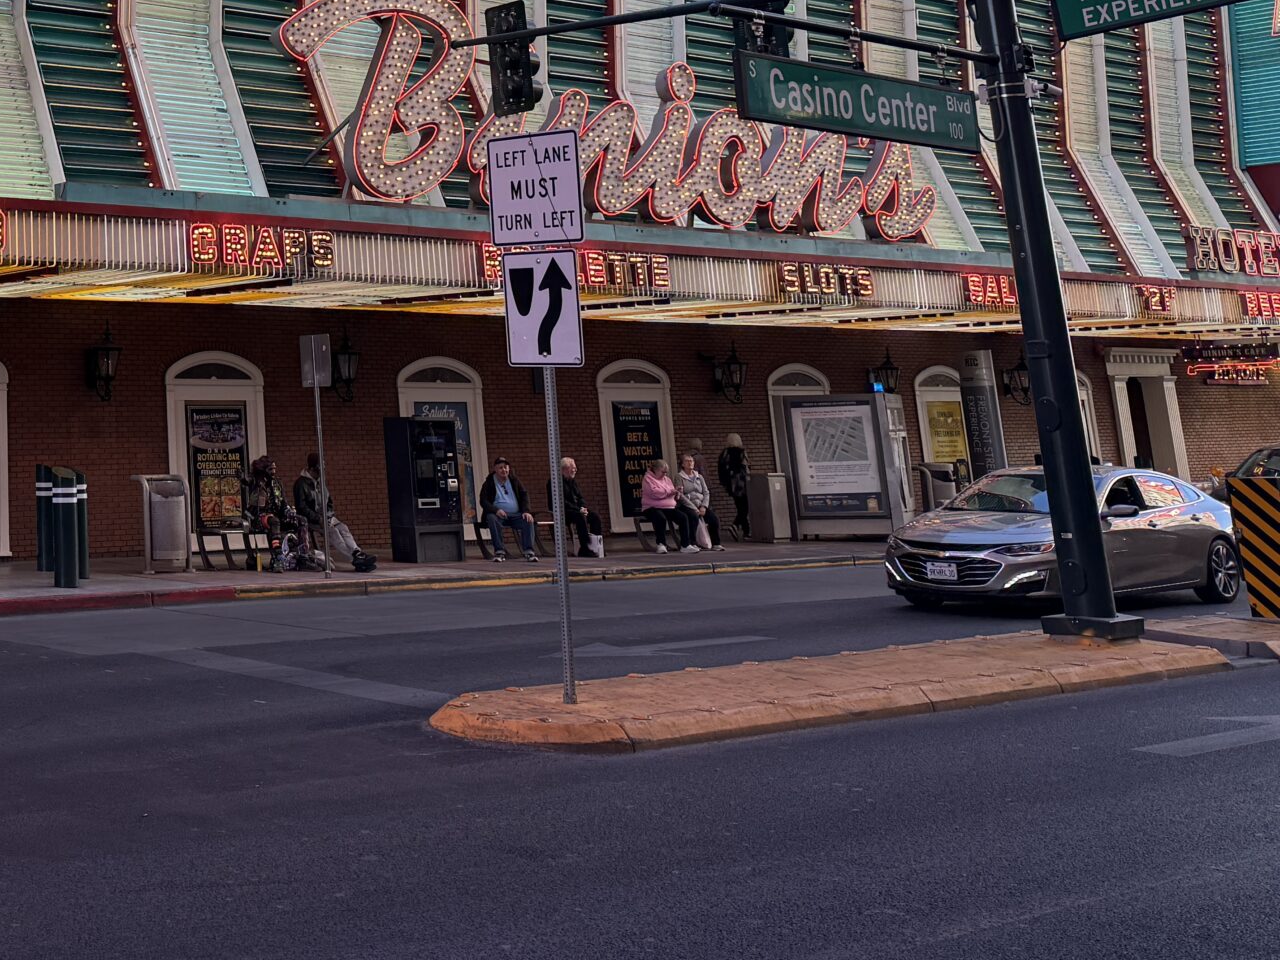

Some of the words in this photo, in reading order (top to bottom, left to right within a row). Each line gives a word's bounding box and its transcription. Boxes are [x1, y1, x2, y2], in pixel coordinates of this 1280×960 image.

[749, 60, 757, 78] S
[770, 68, 853, 120] Casino
[861, 83, 937, 133] Center
[946, 95, 971, 114] Blvd
[949, 122, 964, 140] 100
[496, 150, 527, 168] LEFT
[535, 145, 571, 165] LANE
[511, 177, 558, 200] MUST
[498, 213, 532, 231] TURN
[543, 210, 575, 229] LEFT
[190, 222, 336, 269] CRAPS
[1190, 224, 1280, 277] HOTE
[782, 262, 873, 297] SLOTS
[967, 396, 982, 453] EXPERIENCE
[976, 395, 992, 443] FREMONT
[627, 432, 642, 442] BET
[643, 432, 649, 441] &
[197, 453, 227, 461] ROTATING
[623, 446, 653, 456] WATCH
[197, 462, 241, 470] OVERLOOKING
[625, 460, 640, 470] ALL
